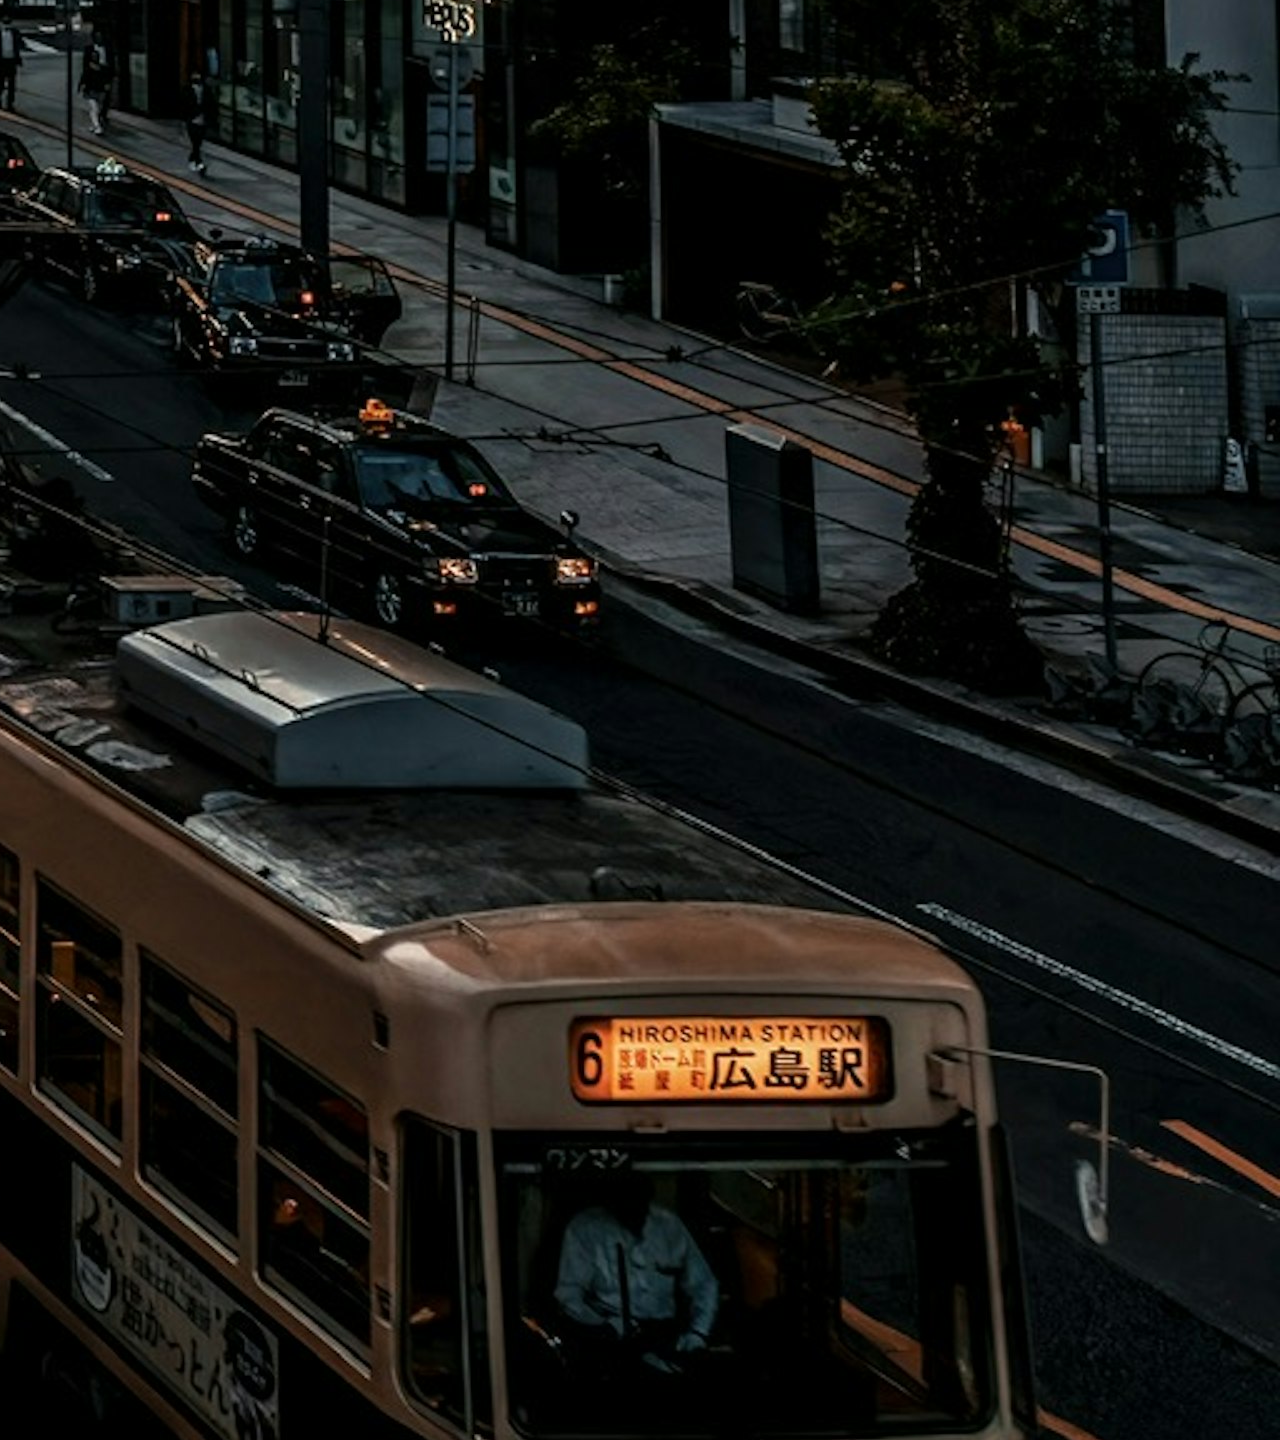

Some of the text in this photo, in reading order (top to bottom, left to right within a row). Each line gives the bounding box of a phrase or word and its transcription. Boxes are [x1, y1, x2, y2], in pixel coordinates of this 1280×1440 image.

[620, 1023, 863, 1044] HIROSHIMA STATION
[576, 1031, 604, 1087] 6
[708, 1046, 865, 1090] 広島駅
[545, 1147, 630, 1171] ワンマン
